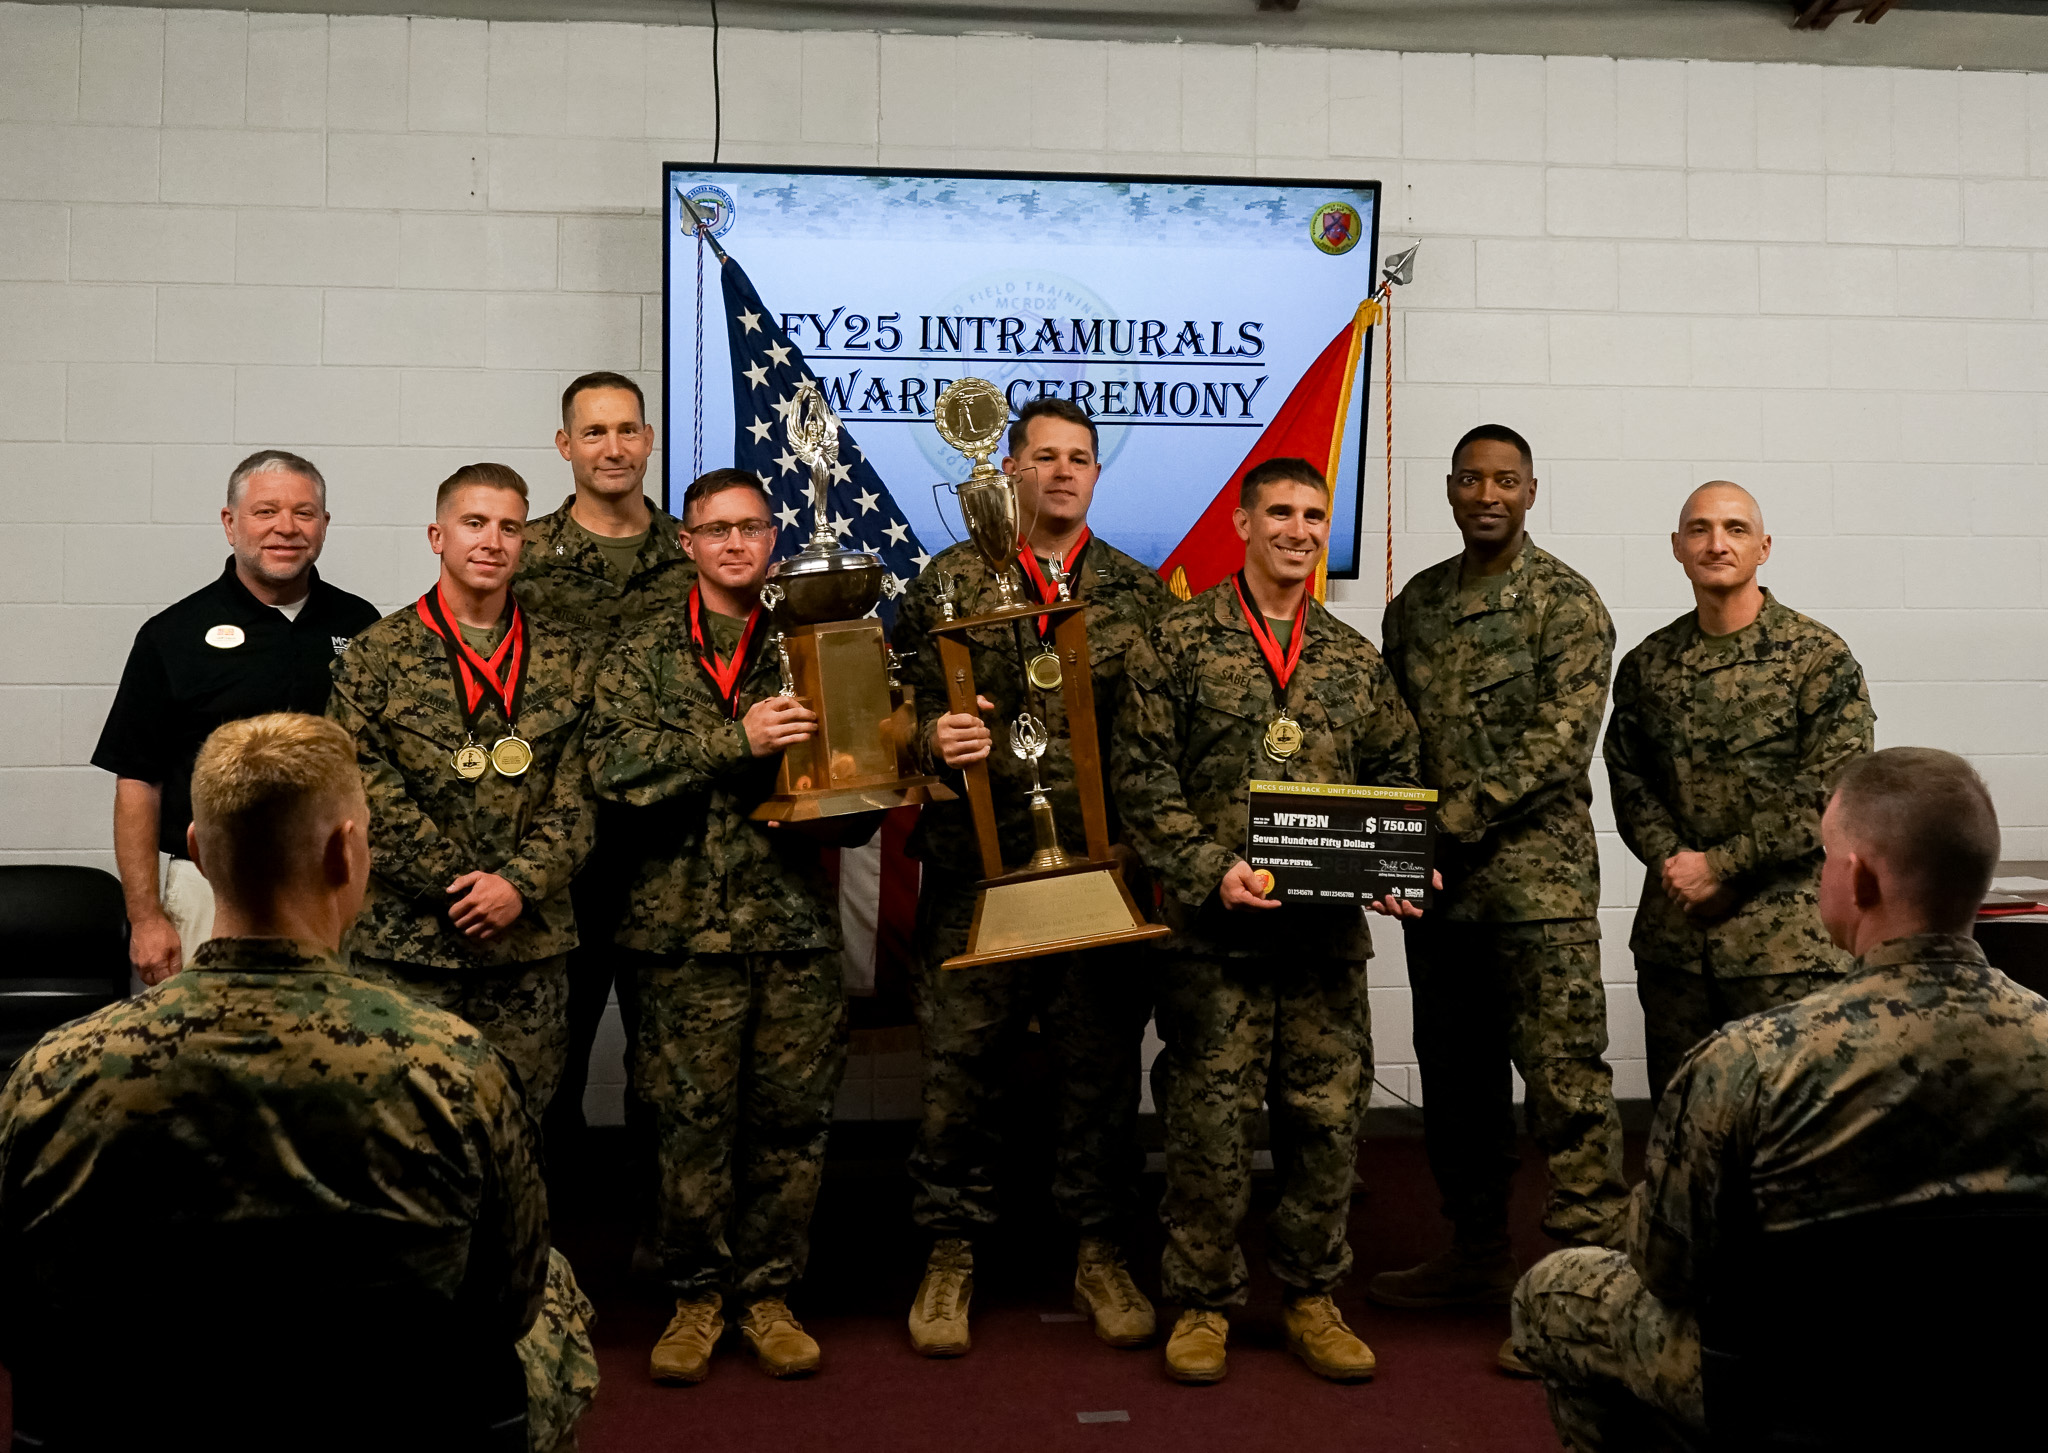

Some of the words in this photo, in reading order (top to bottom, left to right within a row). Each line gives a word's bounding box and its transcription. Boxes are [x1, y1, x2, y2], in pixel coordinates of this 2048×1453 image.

[779, 304, 903, 352] FY25
[919, 314, 1266, 360] INTRAMURALS
[815, 368, 954, 418] WAR
[1219, 669, 1253, 690] SABEL
[1256, 783, 1277, 791] MCCS
[1278, 784, 1300, 792] GIVES
[1327, 787, 1346, 795] UNIT
[1347, 788, 1372, 796] FUNDS
[1373, 790, 1426, 799] OPPORTUNITY
[1273, 812, 1330, 829] WFTBN
[1365, 816, 1377, 835] $
[1382, 820, 1423, 833] 750.00
[1252, 833, 1279, 844] Seven
[1281, 835, 1319, 847] Hundred
[1320, 837, 1342, 849] Fifty
[1343, 838, 1376, 850] Dollars
[1251, 856, 1269, 864] FY25
